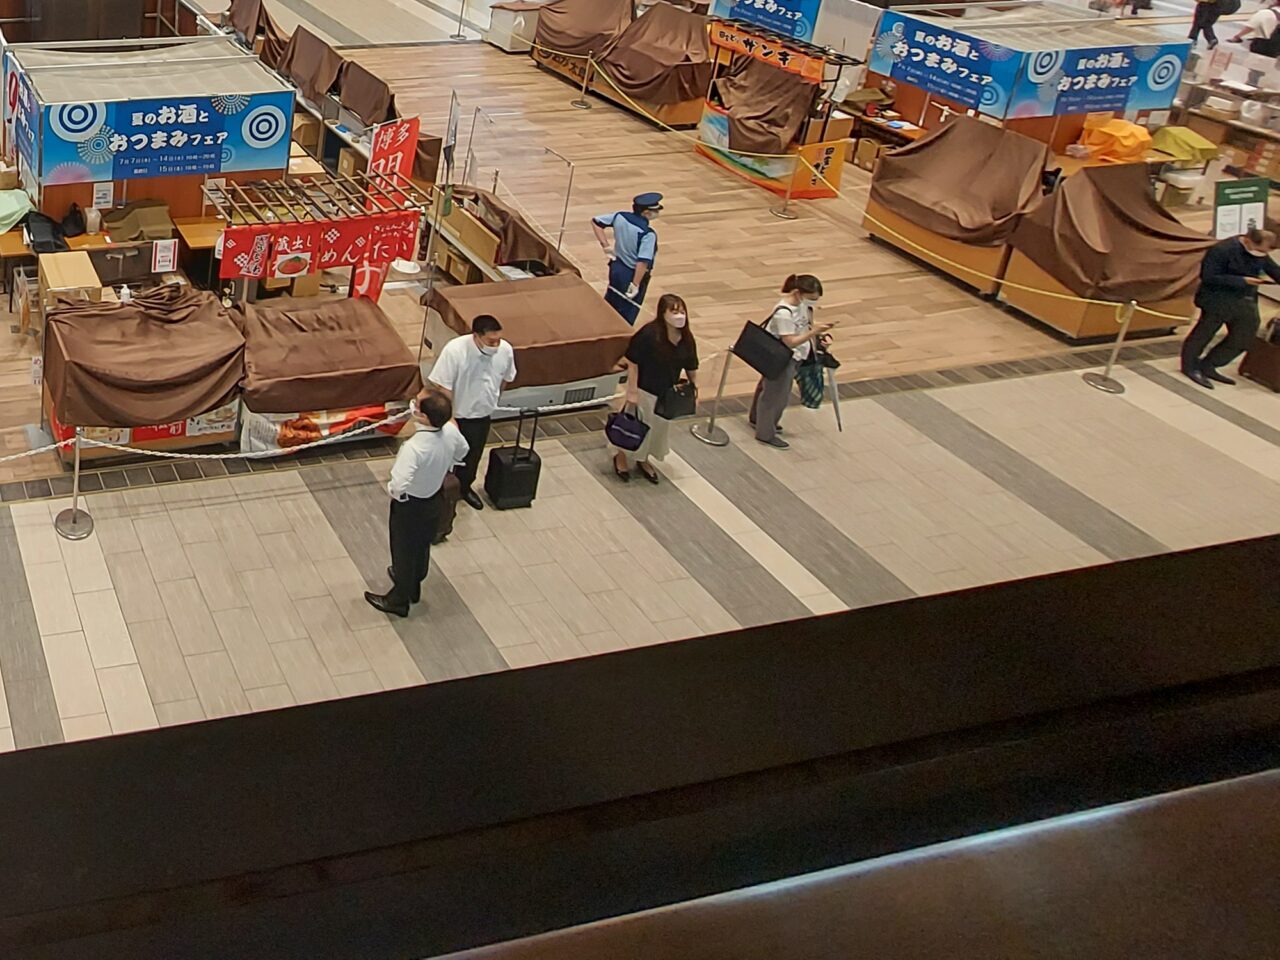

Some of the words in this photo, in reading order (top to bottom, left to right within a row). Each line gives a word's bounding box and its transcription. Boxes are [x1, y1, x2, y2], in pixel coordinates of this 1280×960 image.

[892, 41, 994, 85] おつまみフェア
[1057, 73, 1138, 92] おつまみフェア
[131, 104, 209, 127] 夏のお酒と
[109, 130, 229, 152] おつまみフェア
[376, 123, 411, 153] 博多
[275, 234, 312, 253] 蔵出し
[321, 240, 408, 263] めんたい
